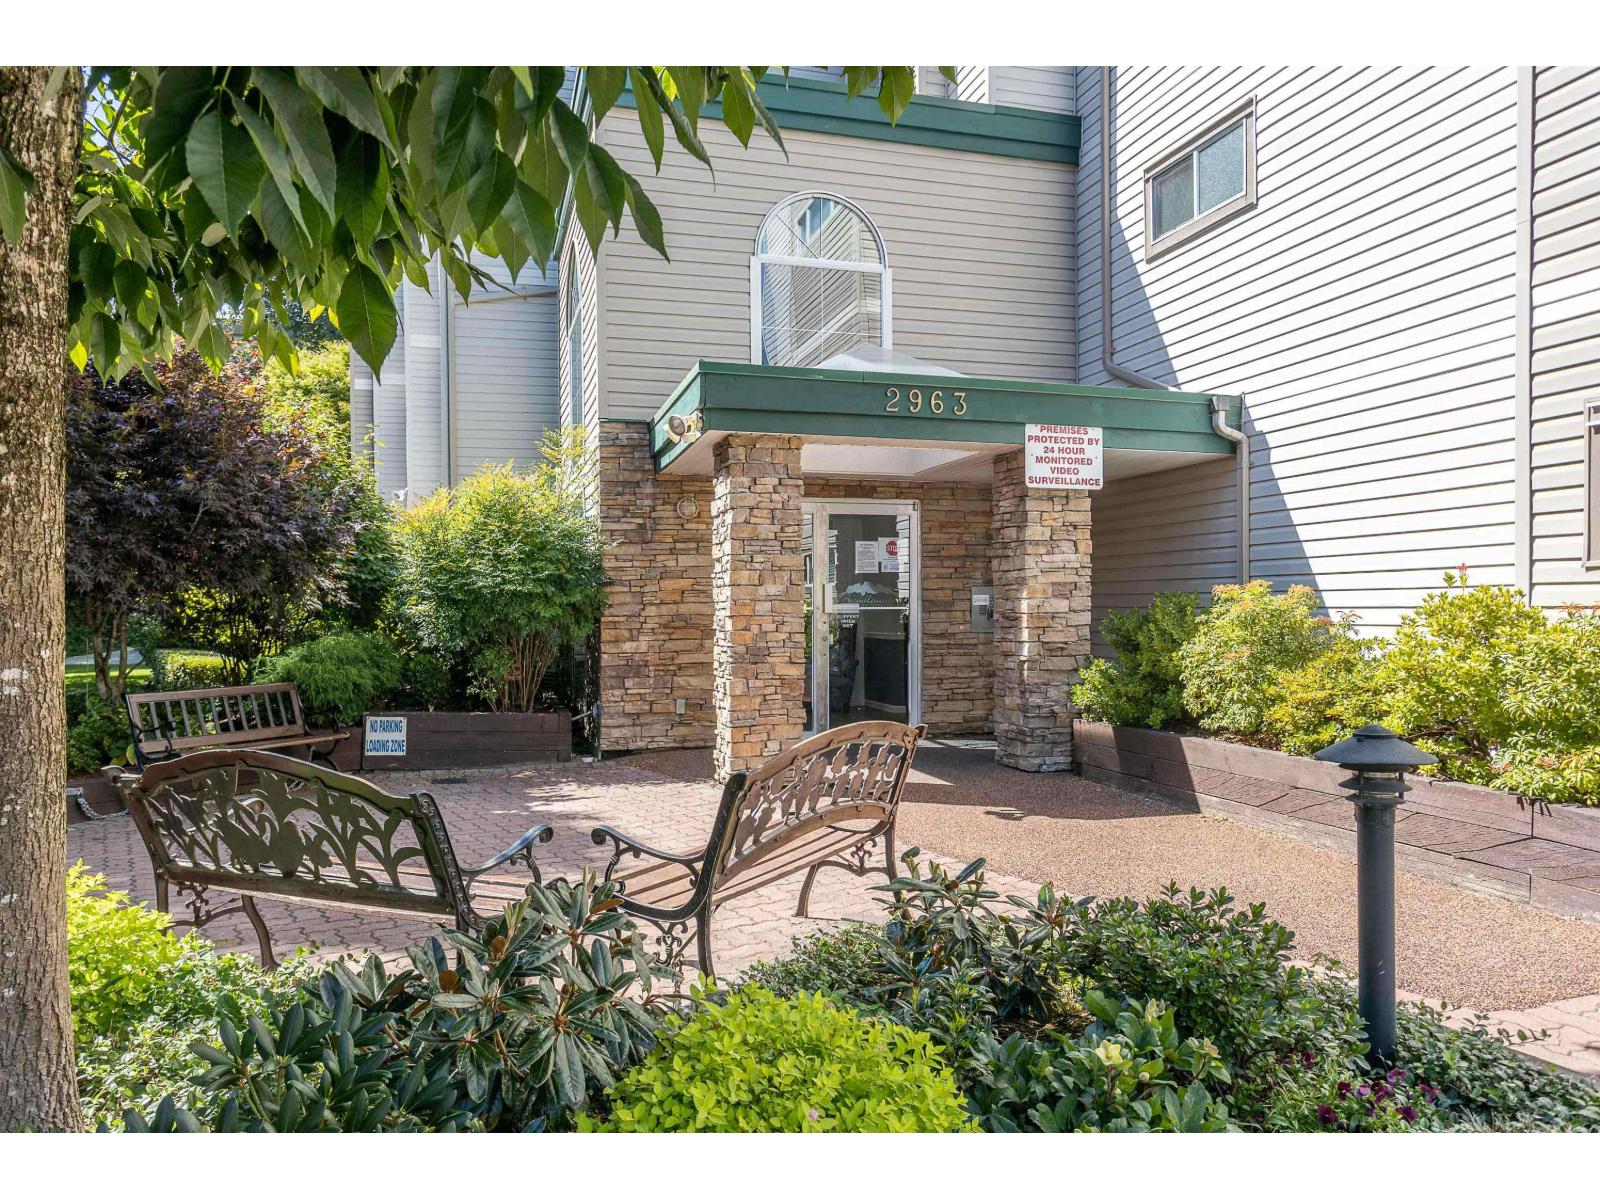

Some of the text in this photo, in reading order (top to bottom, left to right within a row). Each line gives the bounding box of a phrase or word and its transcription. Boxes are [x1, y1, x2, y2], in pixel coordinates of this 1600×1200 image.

[886, 387, 967, 415] 2963
[1039, 425, 1089, 435] PREMISES
[1027, 435, 1100, 446] PROTECTED BY
[1043, 446, 1086, 455] 24 HOUR
[1035, 456, 1093, 466] MONITORED
[1050, 466, 1080, 475] VIDEO
[1028, 476, 1101, 486] SURVEILLANCE
[370, 719, 403, 733] NO PARKING
[367, 739, 405, 752] LOADING ZONE
